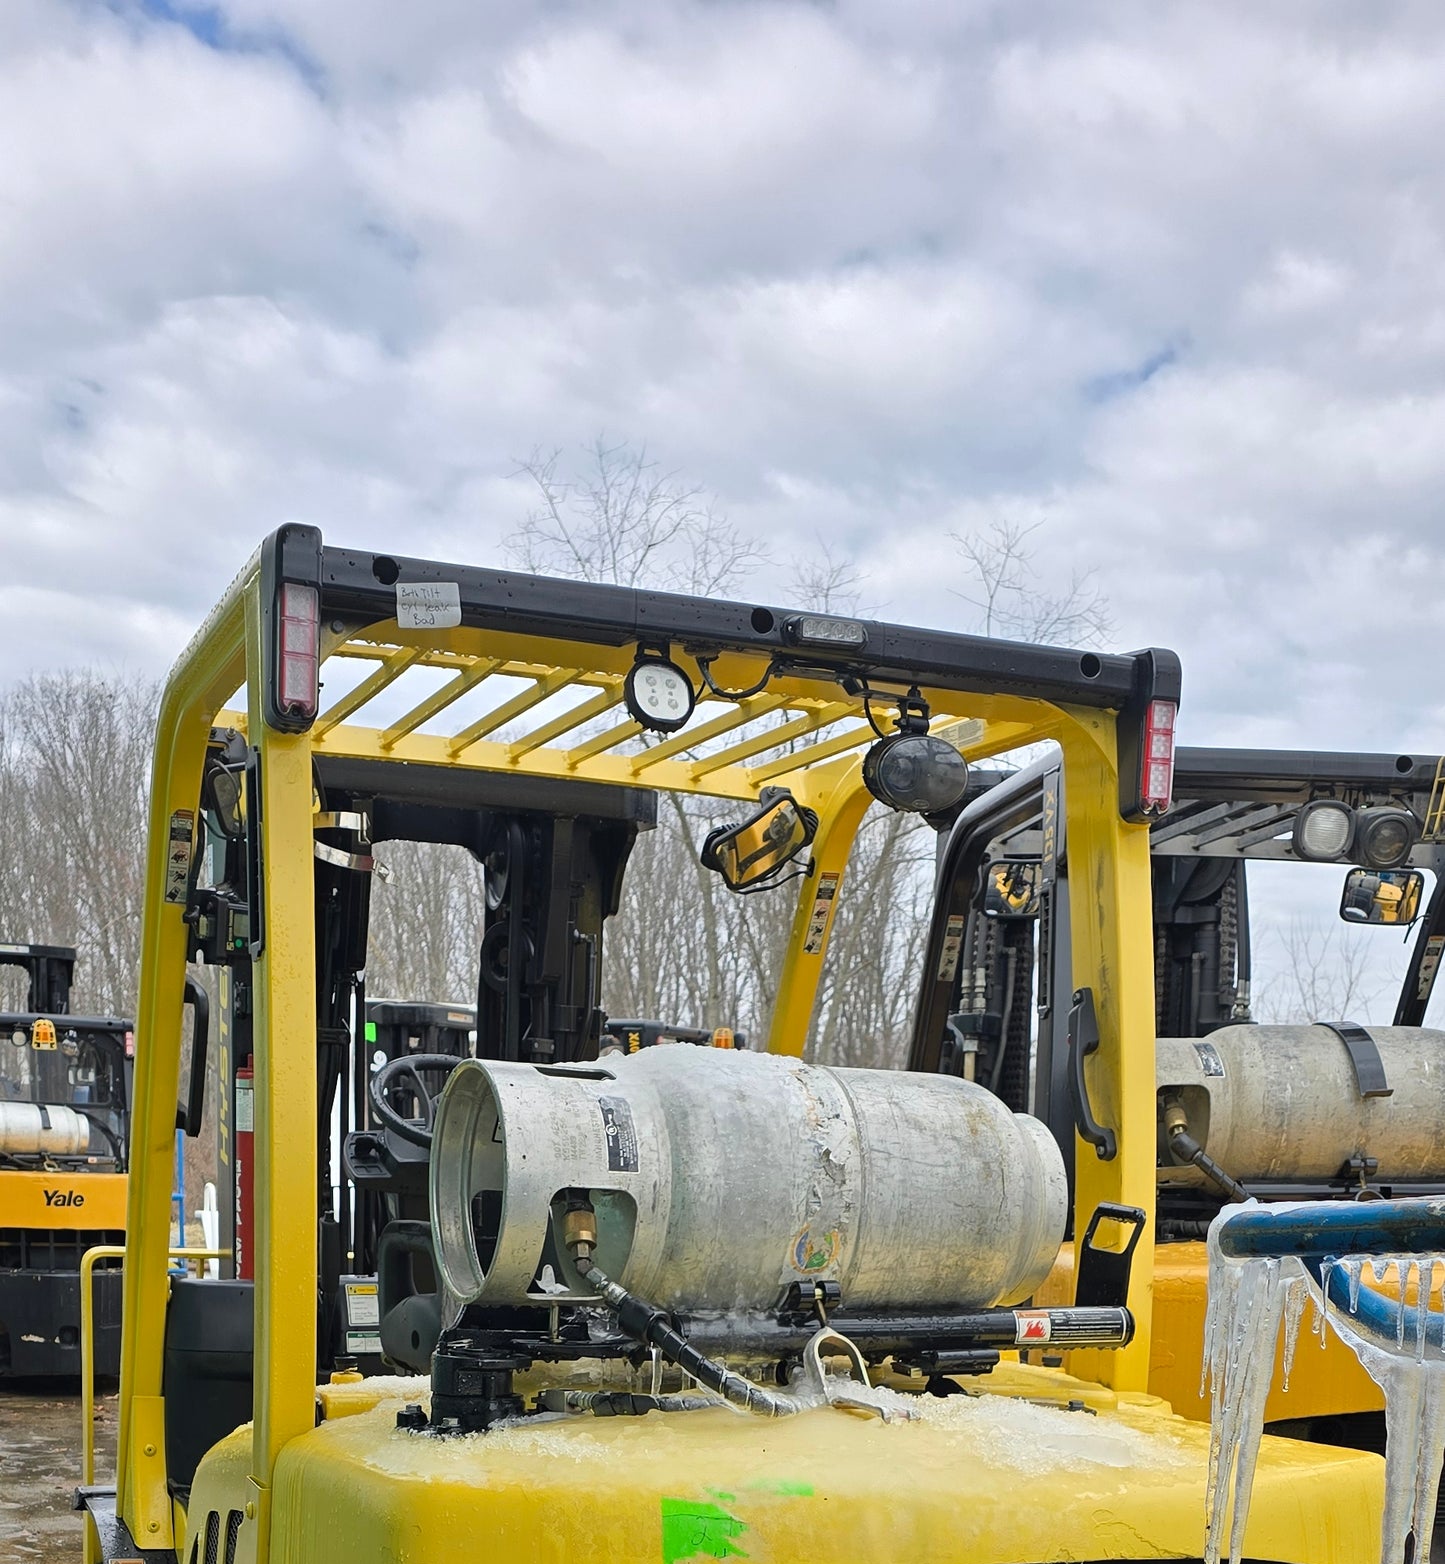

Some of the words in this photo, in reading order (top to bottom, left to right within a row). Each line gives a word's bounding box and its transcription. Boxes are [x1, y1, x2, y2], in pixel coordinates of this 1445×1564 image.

[413, 613, 435, 625] Bad
[219, 965, 229, 1167] HYSTE
[43, 1190, 84, 1207] Yale
